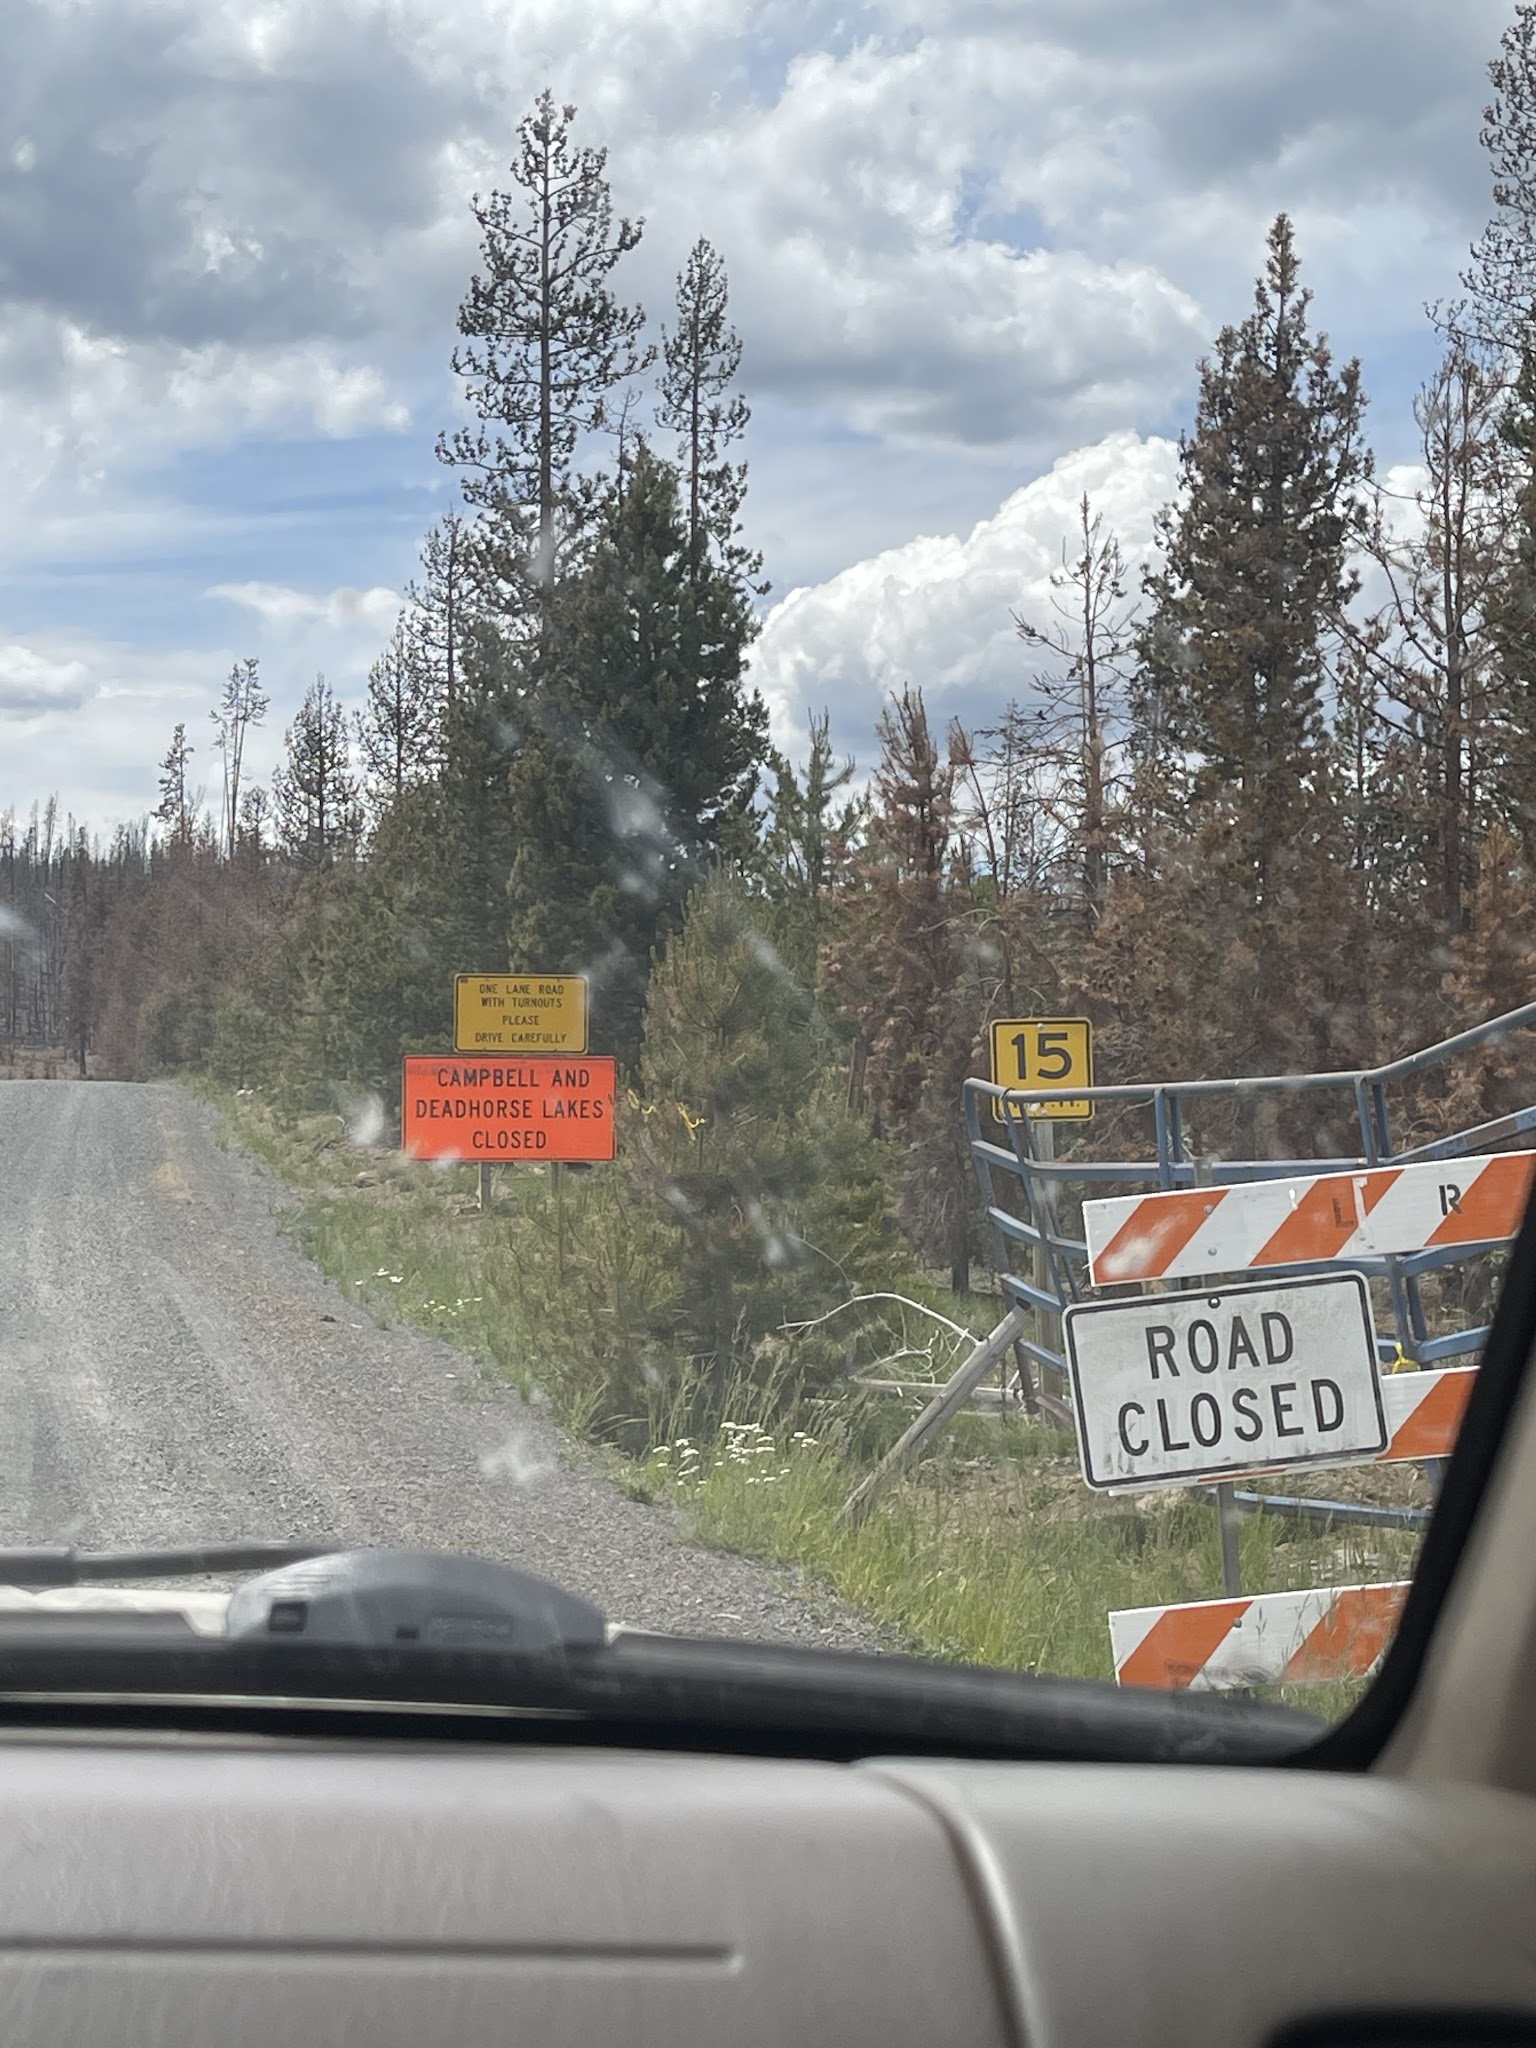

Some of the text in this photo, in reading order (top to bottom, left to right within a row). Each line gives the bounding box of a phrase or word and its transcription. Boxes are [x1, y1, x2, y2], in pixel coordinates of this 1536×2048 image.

[479, 984, 565, 995] ONE LANE ROAD
[481, 997, 562, 1009] WITH TURNOUTS
[502, 1015, 540, 1026] PLEASE
[474, 1032, 567, 1044] DRIVE CAREFULLY
[1011, 1032, 1073, 1080] 15
[437, 1068, 590, 1088] CAMPBELL AND
[415, 1099, 604, 1119] DEADHORSE LAKES
[472, 1130, 547, 1149] CLOSED
[1145, 1311, 1294, 1380] ROAD
[1117, 1379, 1345, 1457] CLOSED
